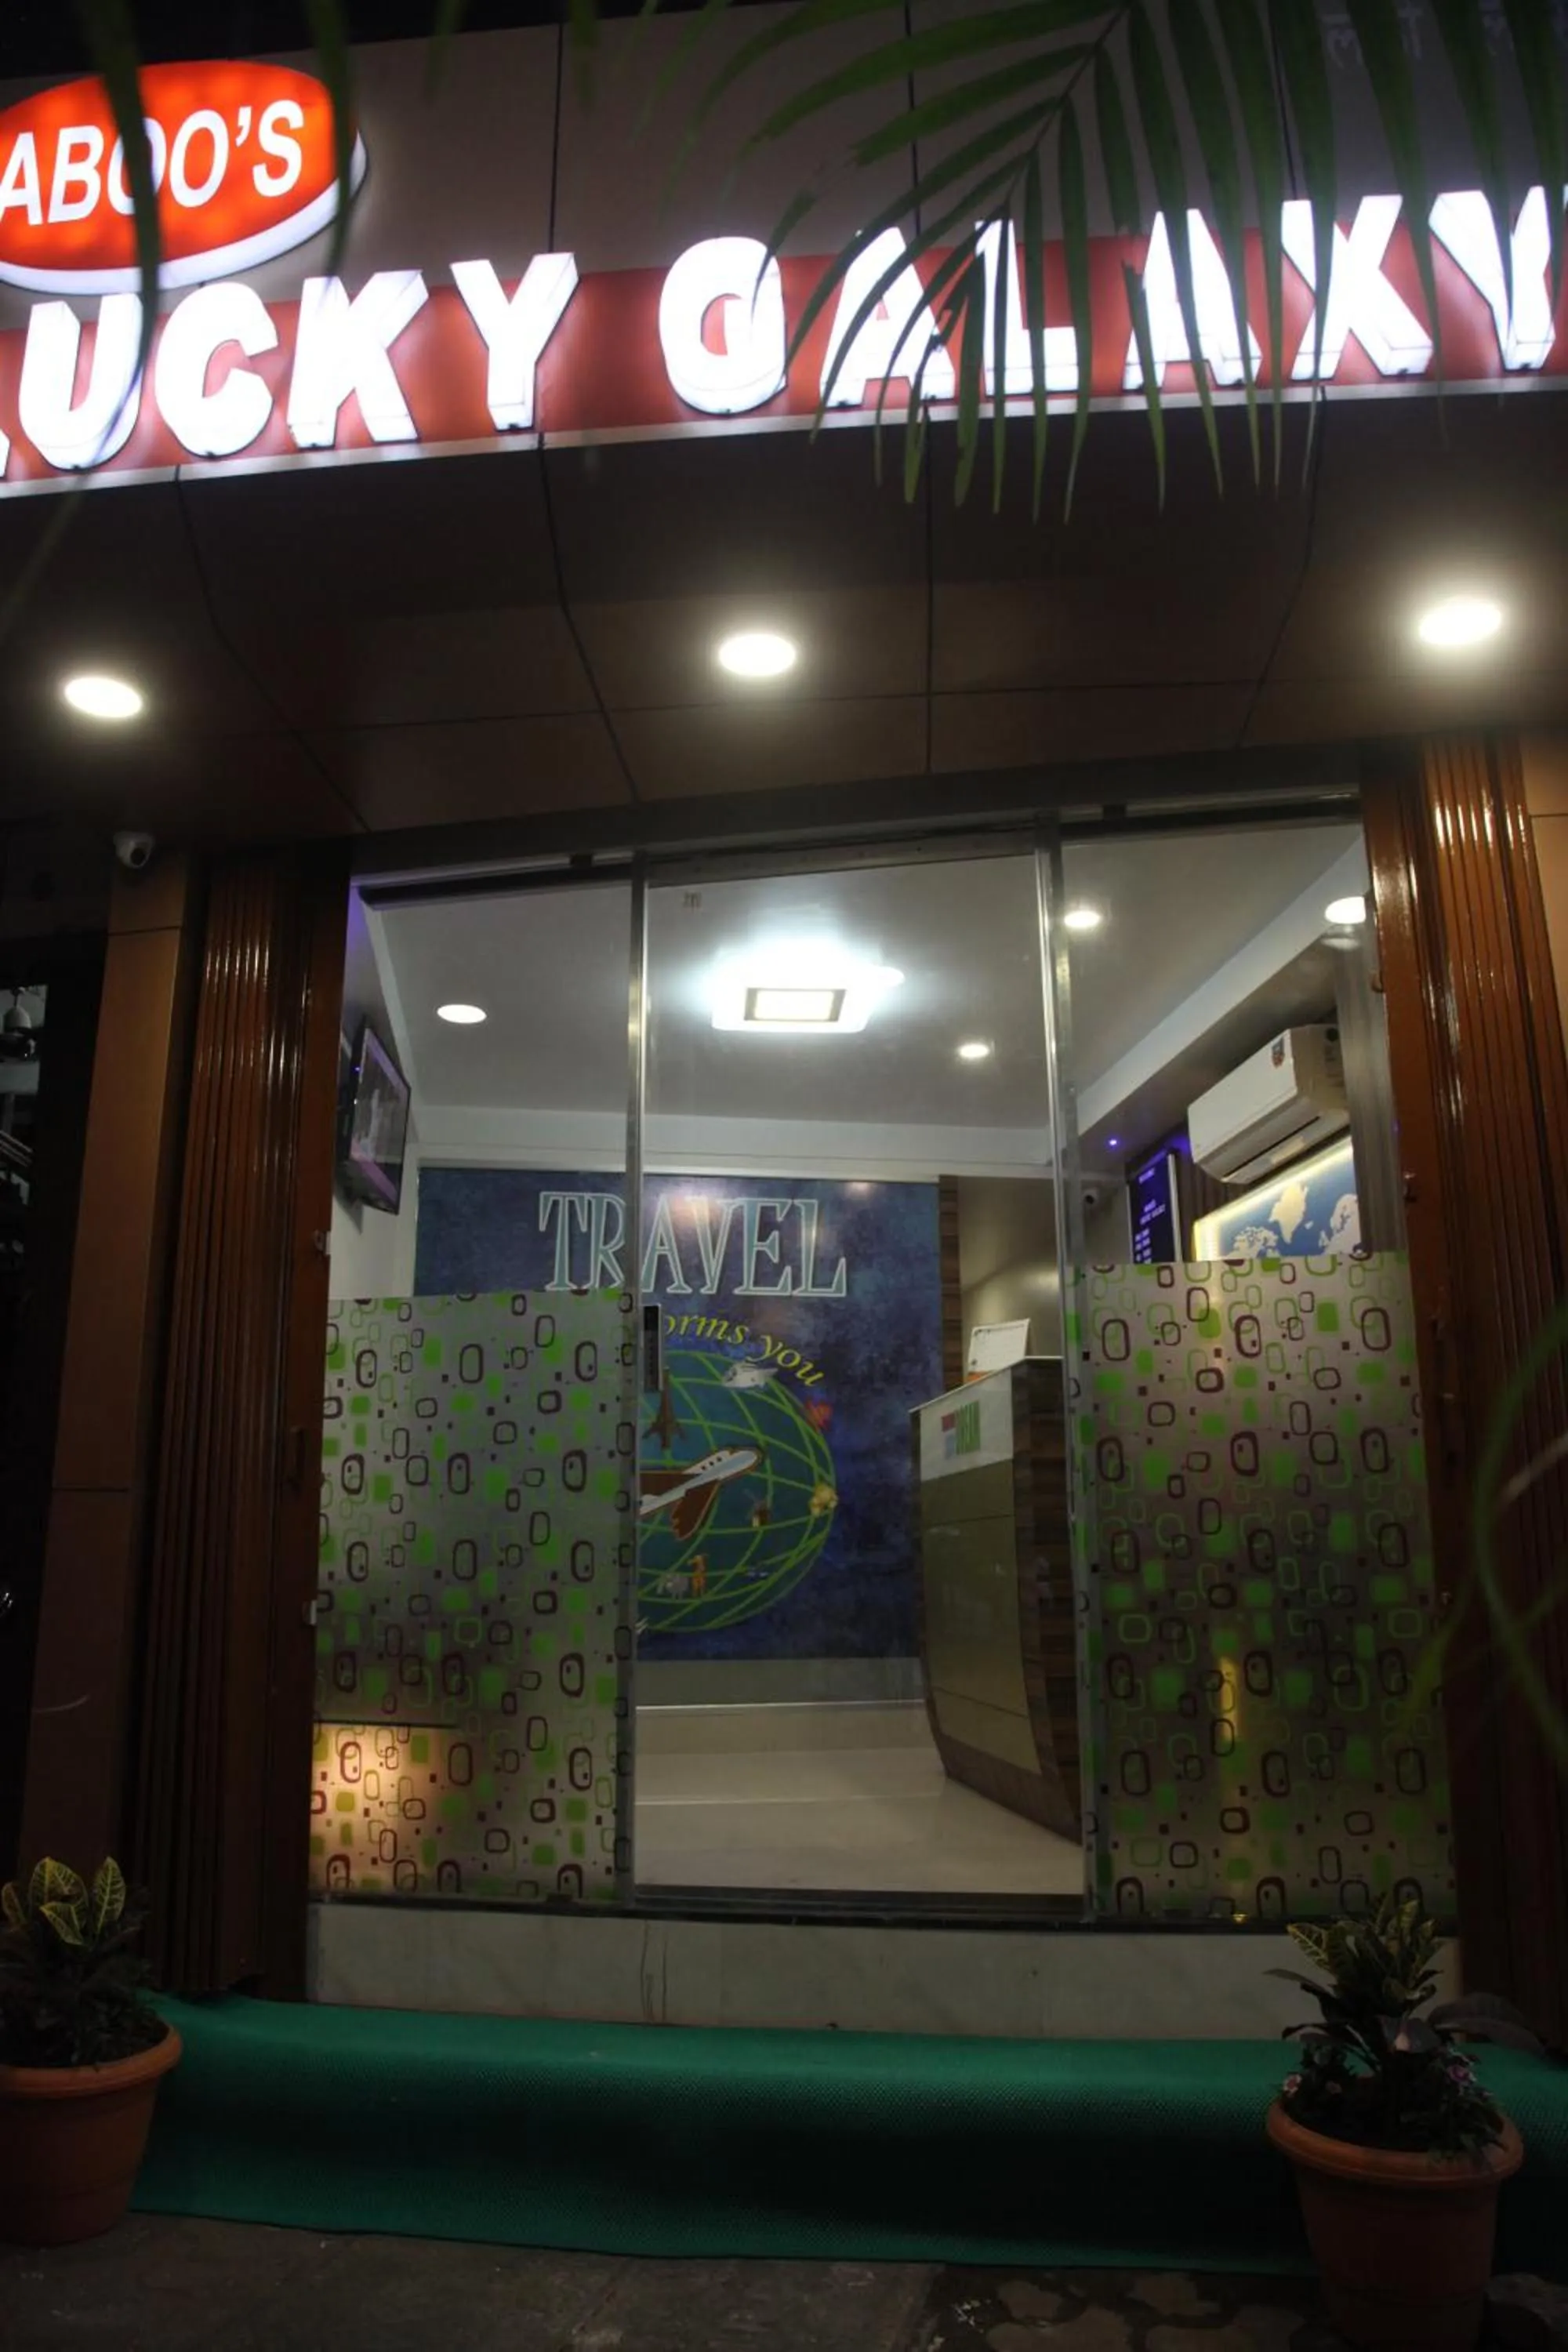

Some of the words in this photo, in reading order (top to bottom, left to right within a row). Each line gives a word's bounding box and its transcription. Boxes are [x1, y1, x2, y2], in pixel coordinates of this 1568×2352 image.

[0, 252, 579, 472] UCKY
[659, 183, 1568, 416] GALAXY
[539, 1191, 847, 1298] TRAVEL
[746, 1334, 825, 1388] you
